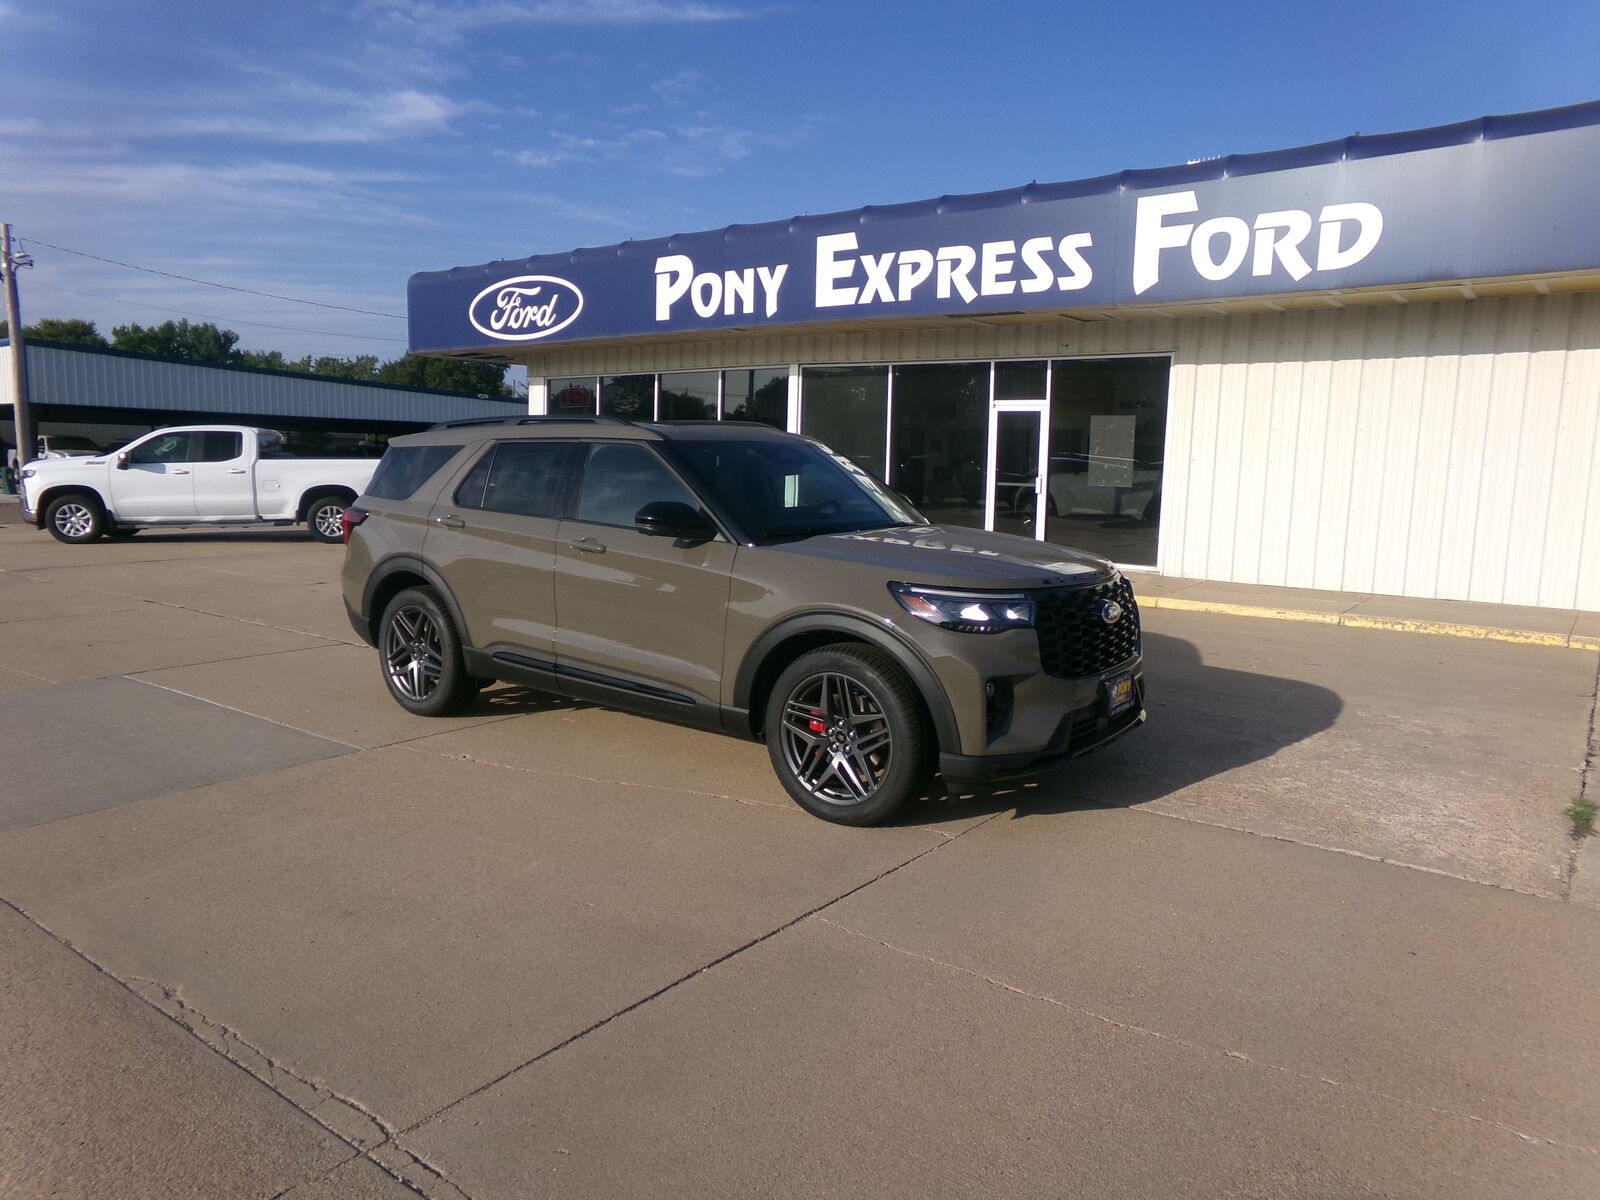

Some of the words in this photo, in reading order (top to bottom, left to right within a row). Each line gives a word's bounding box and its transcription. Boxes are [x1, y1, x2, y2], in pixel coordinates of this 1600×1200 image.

[654, 255, 789, 321] PONY
[815, 232, 1093, 308] EXPRESS
[1133, 190, 1384, 296] FORD
[489, 286, 559, 330] Ford
